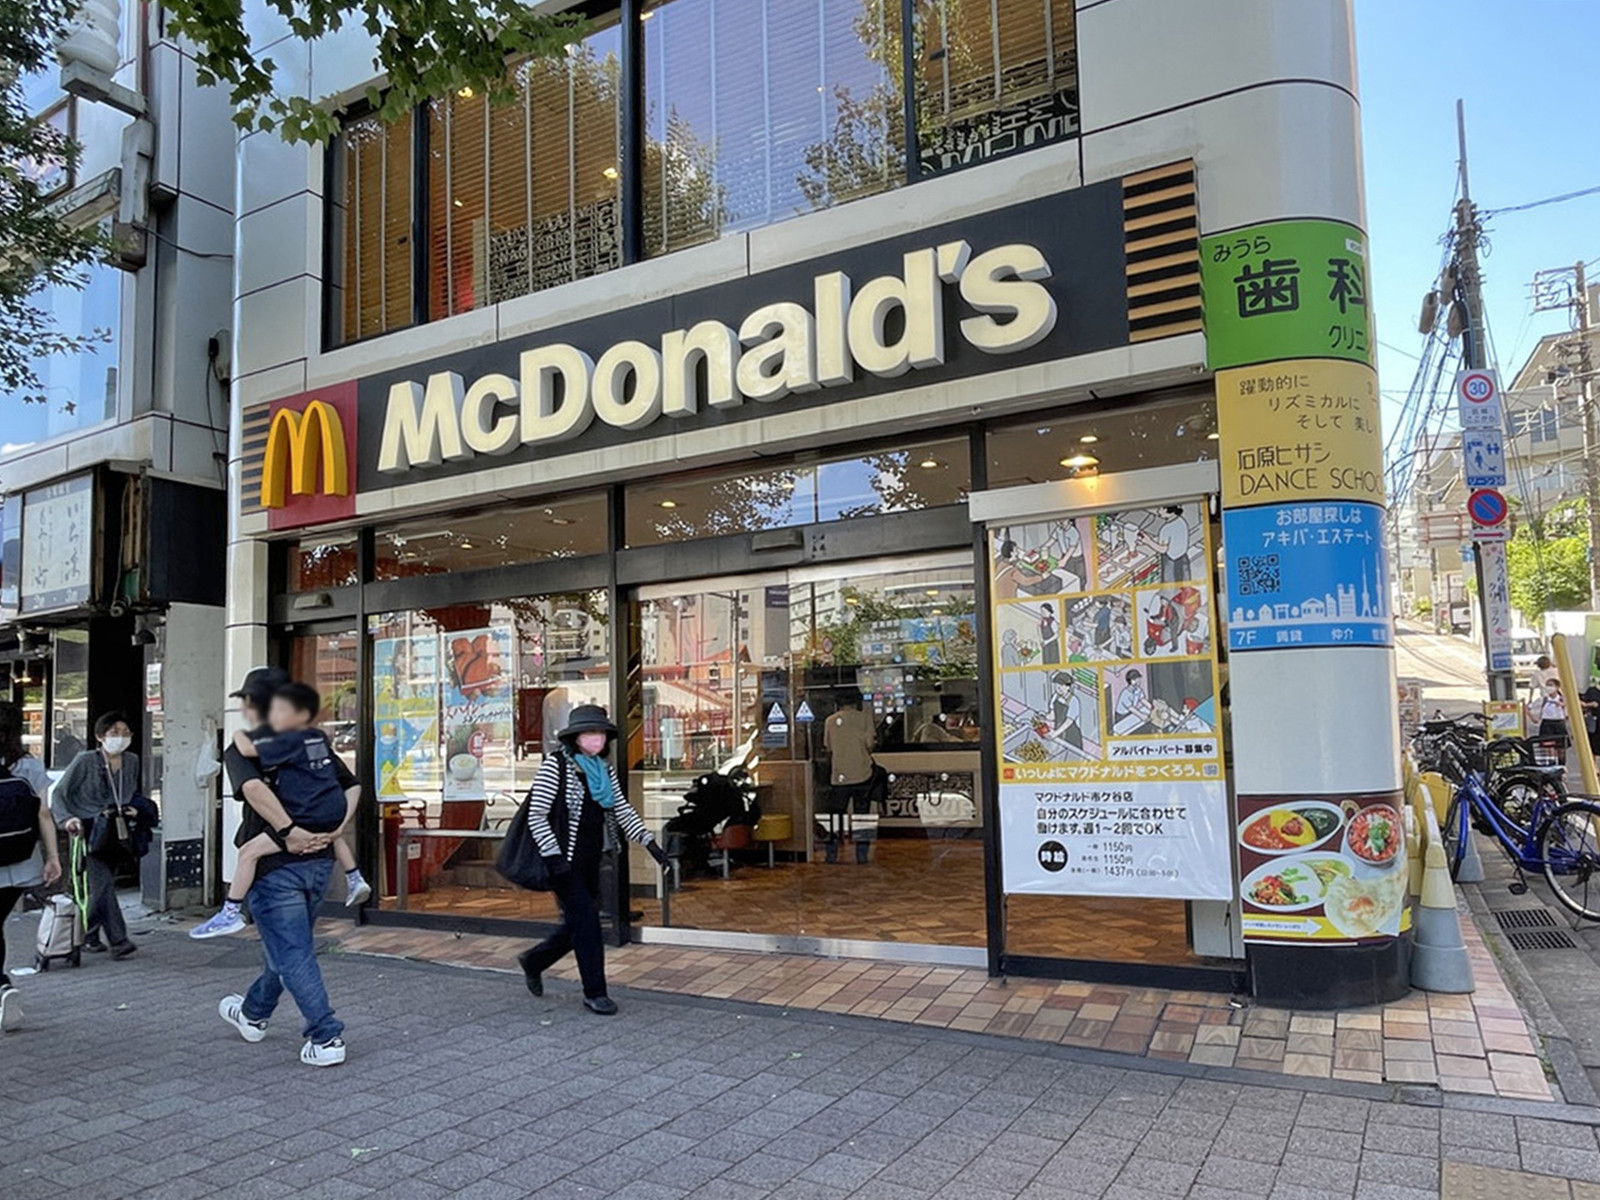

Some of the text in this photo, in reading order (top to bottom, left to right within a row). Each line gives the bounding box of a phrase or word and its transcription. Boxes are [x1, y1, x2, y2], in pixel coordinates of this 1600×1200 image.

[1213, 236, 1271, 262] みうら
[378, 241, 1057, 472] McDonald's
[1469, 381, 1487, 395] 30
[1268, 394, 1361, 412] リズミカルに
[1296, 414, 1342, 429] そして
[1238, 442, 1331, 470] 石原ヒサシ
[1240, 468, 1318, 496] DANCE
[1276, 507, 1362, 526] お部屋探しは
[1262, 528, 1373, 548] アキバ・エステート
[1236, 631, 1257, 645] 7F
[1036, 806, 1187, 821] 自分のスケジュールに合わせて
